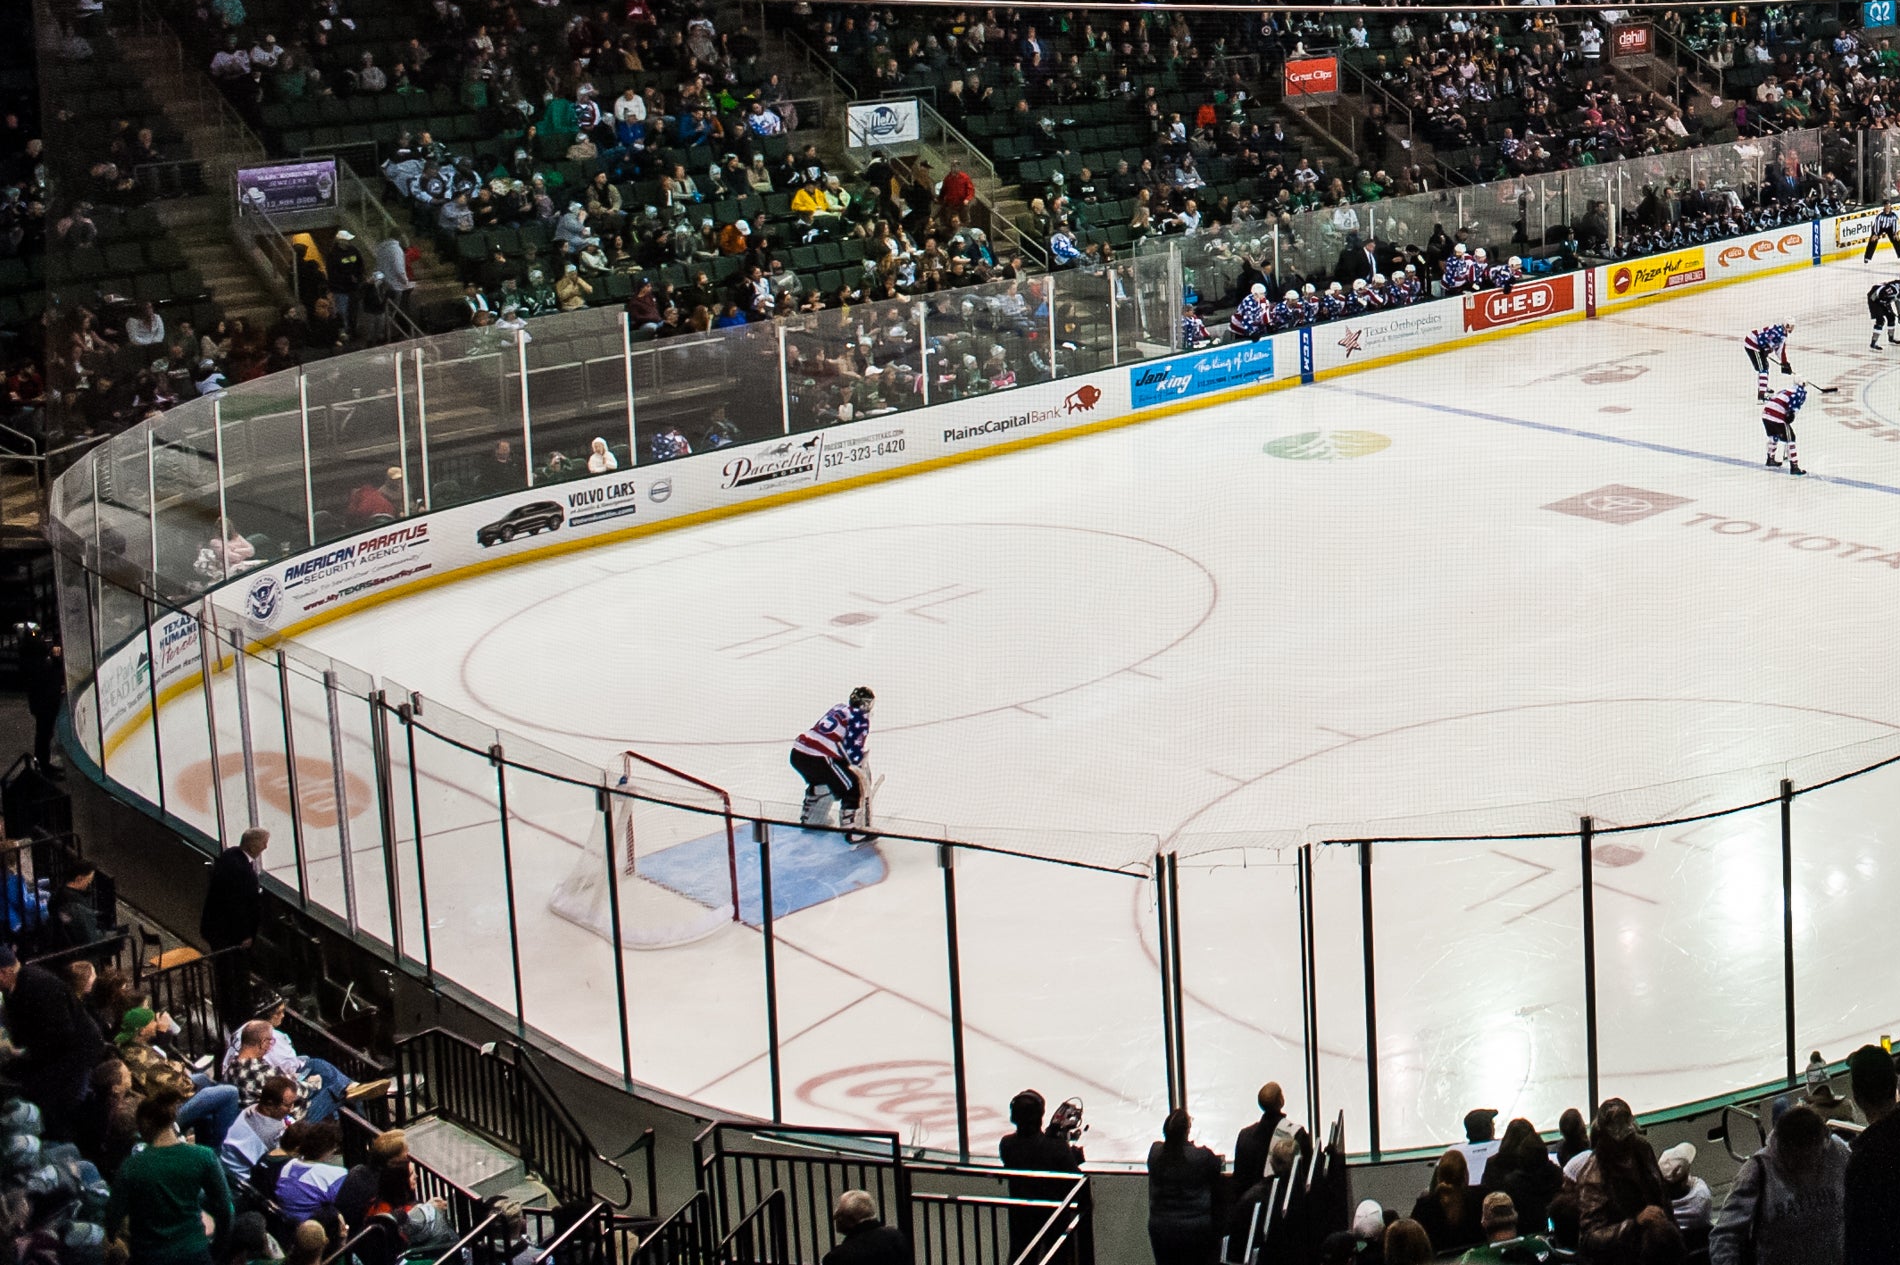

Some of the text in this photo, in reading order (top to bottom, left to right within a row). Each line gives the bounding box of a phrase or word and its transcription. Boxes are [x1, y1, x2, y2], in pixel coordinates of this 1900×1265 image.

[1869, 0, 1890, 22] Q2
[1619, 29, 1645, 46] dahill
[1290, 71, 1332, 82] Great Clips
[1634, 259, 1682, 287] Pizza Hut
[1364, 327, 1388, 337] Texas
[1391, 314, 1442, 331] Orthopedics
[1194, 358, 1210, 373] The
[1211, 358, 1231, 372] King
[1234, 353, 1243, 370] of
[1302, 333, 1310, 371] CCM
[1136, 366, 1170, 387] Jani
[824, 439, 906, 468] 512-323-6420
[721, 452, 815, 489] Pacesetter
[568, 488, 604, 508] VOLVO
[607, 481, 635, 500] CARS
[284, 546, 355, 582] AMERICAN
[358, 523, 428, 556] PARATUS
[304, 560, 357, 585] SECURITY
[359, 543, 408, 566] AGENCY
[163, 616, 191, 635] TEXAS
